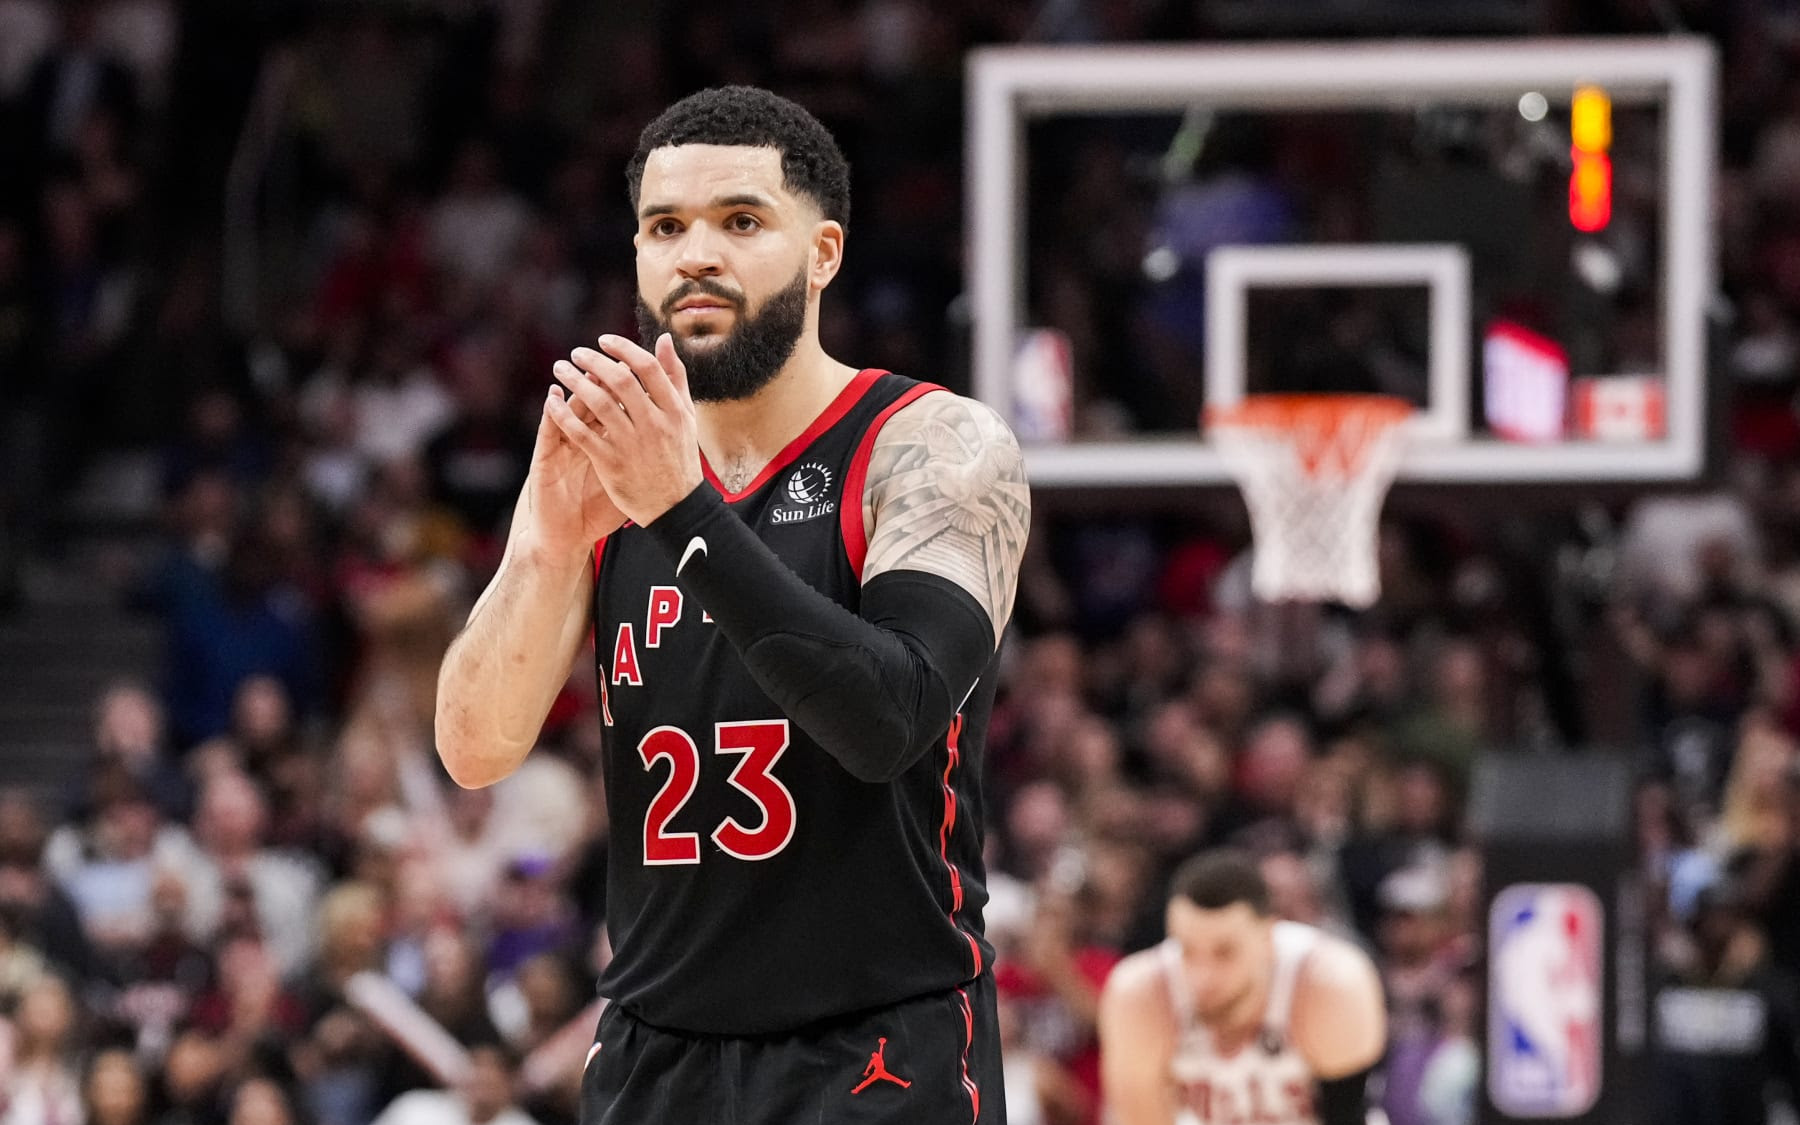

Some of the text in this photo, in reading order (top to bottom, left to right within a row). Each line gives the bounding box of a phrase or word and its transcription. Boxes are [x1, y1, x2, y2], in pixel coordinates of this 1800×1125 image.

[772, 500, 835, 523] Sun Life
[637, 718, 797, 866] 23
